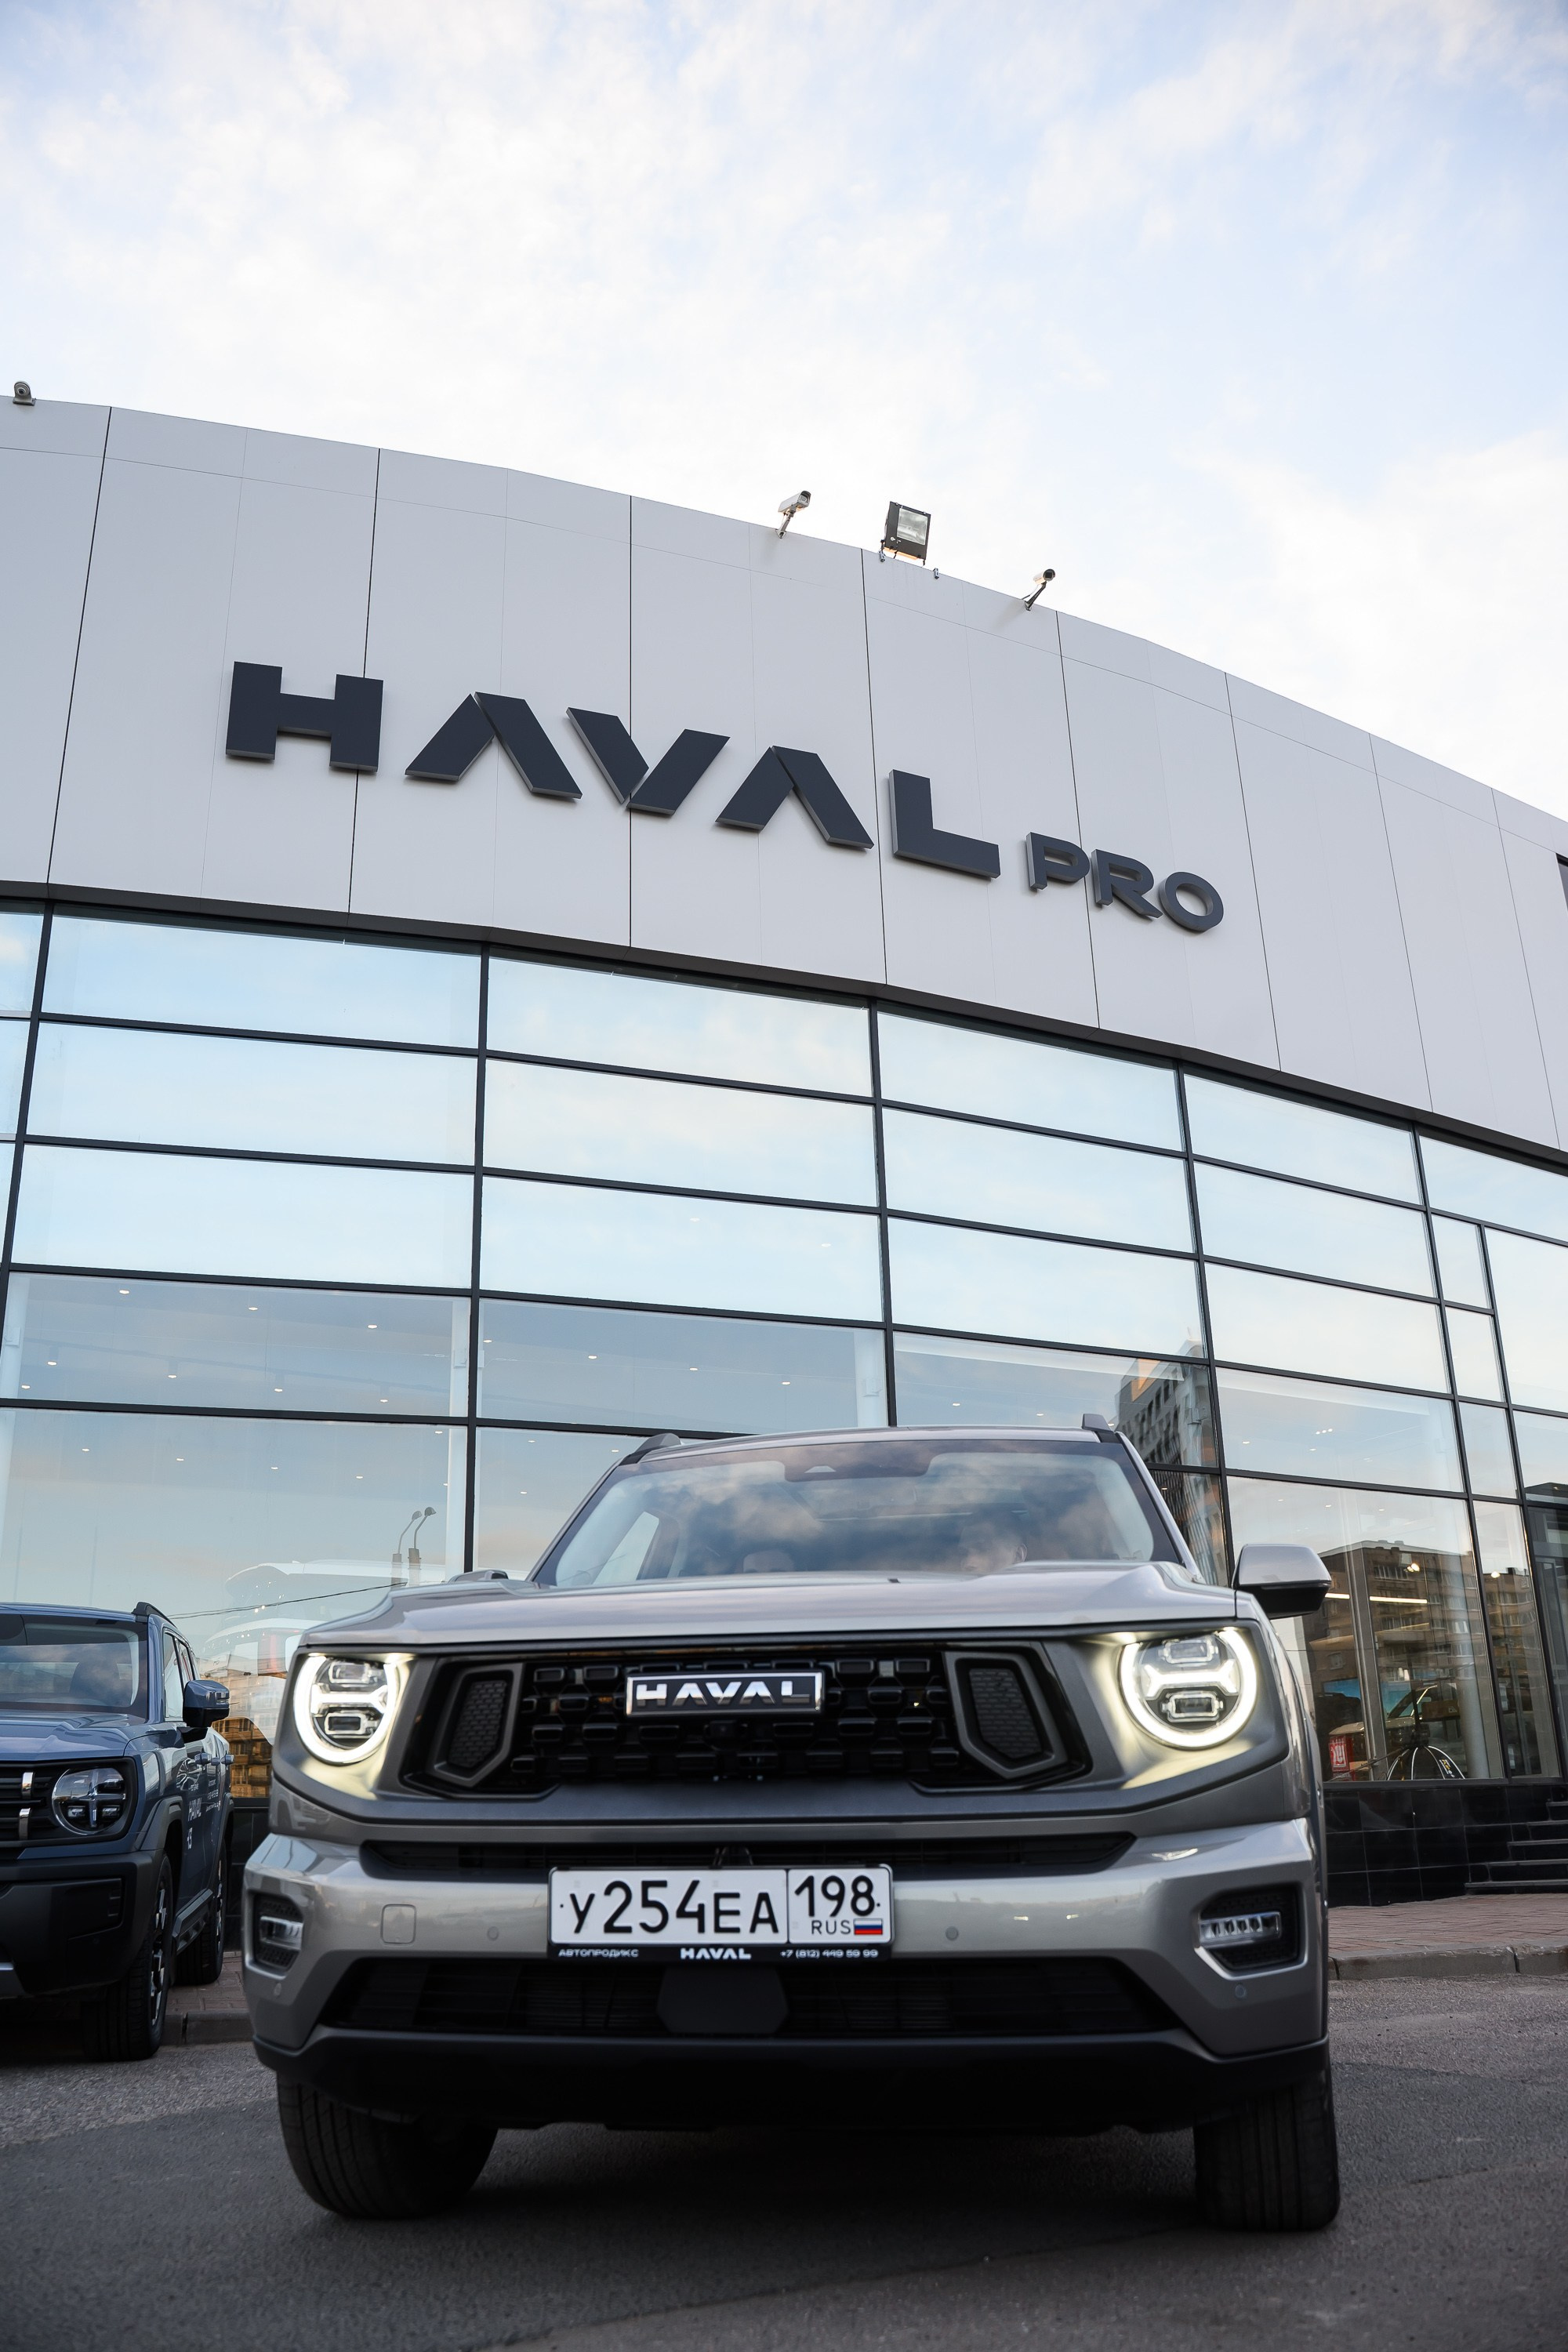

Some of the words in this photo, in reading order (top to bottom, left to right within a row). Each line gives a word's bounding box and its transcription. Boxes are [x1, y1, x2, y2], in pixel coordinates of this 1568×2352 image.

[225, 661, 1000, 882] HAVAL
[1025, 831, 1225, 933] PRO
[636, 1680, 811, 1707] HAVAL
[793, 1875, 876, 1918] 198
[811, 1919, 851, 1935] RUS
[557, 1948, 640, 1958] АВТОПРОДИКС
[680, 1947, 752, 1960] HAVAL
